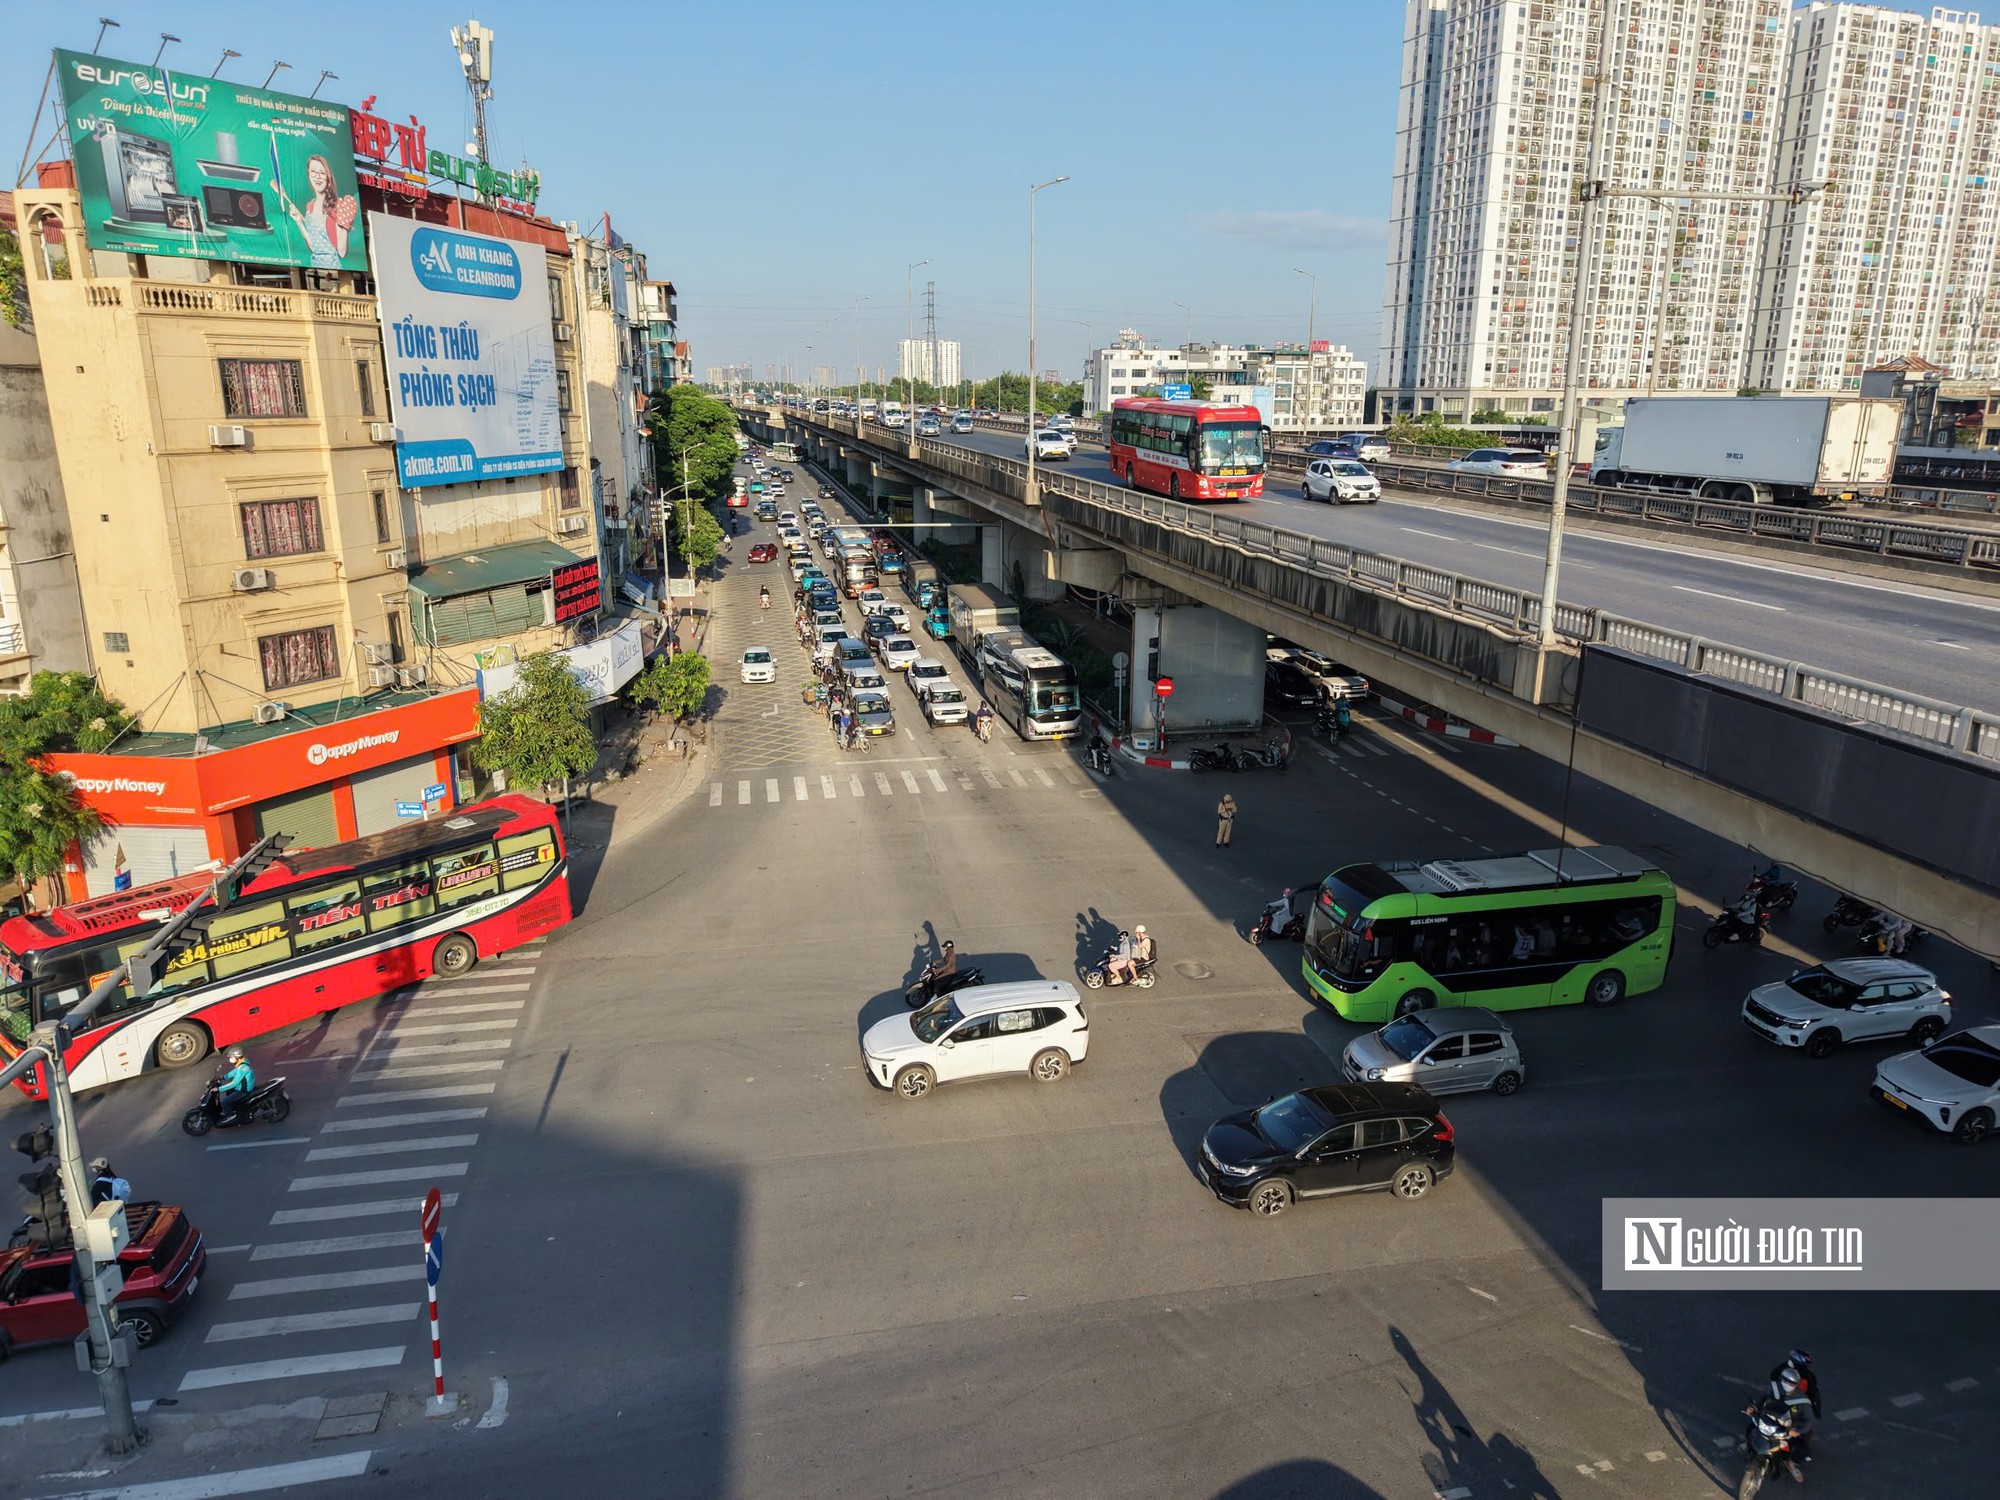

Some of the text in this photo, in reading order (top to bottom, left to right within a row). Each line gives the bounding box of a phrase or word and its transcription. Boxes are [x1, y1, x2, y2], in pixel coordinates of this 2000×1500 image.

[101, 98, 132, 116] Dùng
[133, 103, 145, 115] là
[173, 112, 198, 128] ngay
[261, 99, 275, 110] NHÀ
[275, 100, 287, 112] BẾP
[287, 104, 303, 115] NHẬP
[274, 127, 290, 135] công
[305, 122, 317, 130] tiên
[317, 125, 336, 134] phong
[394, 115, 427, 172] TỪ
[455, 244, 513, 267] ANH KHANG
[457, 267, 515, 289] CLEANROOM
[392, 313, 480, 361] TỔNG THẦU
[399, 365, 496, 413] PHÒNG SẠCH
[404, 453, 473, 478] akme.com.vn
[358, 730, 400, 750] Money
[114, 778, 165, 795] Money
[373, 884, 429, 910] TIẾN
[180, 945, 208, 965] 34
[209, 938, 248, 957] PHÒNG
[299, 903, 362, 932] TIẾN
